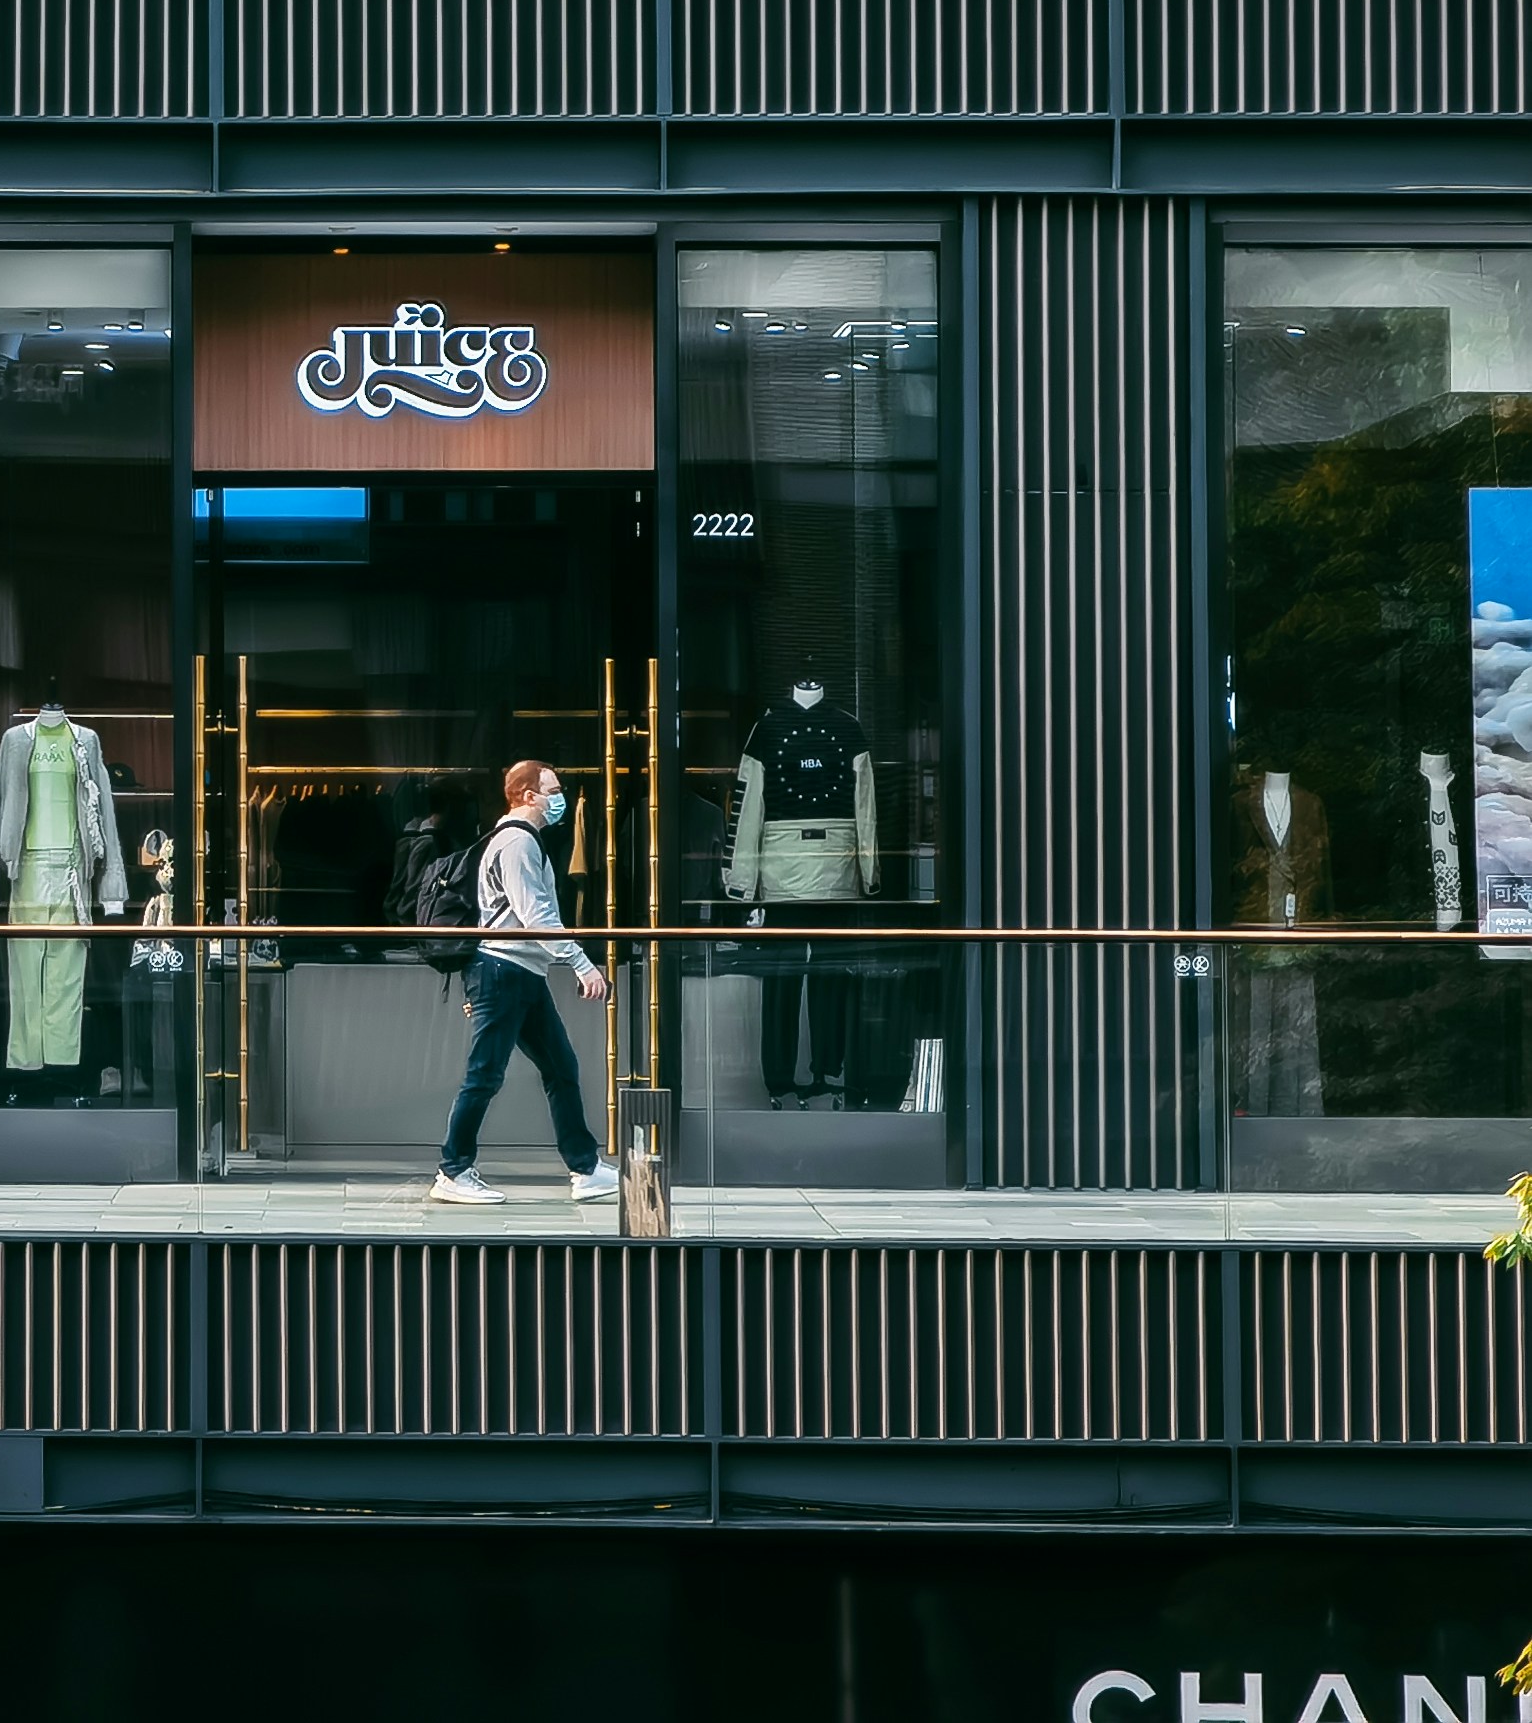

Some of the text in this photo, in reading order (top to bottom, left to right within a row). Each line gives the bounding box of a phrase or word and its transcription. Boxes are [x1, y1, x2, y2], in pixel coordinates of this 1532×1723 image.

[693, 513, 754, 536] 2222
[800, 758, 823, 768] HBA
[1072, 1670, 1532, 1723] CHAN
